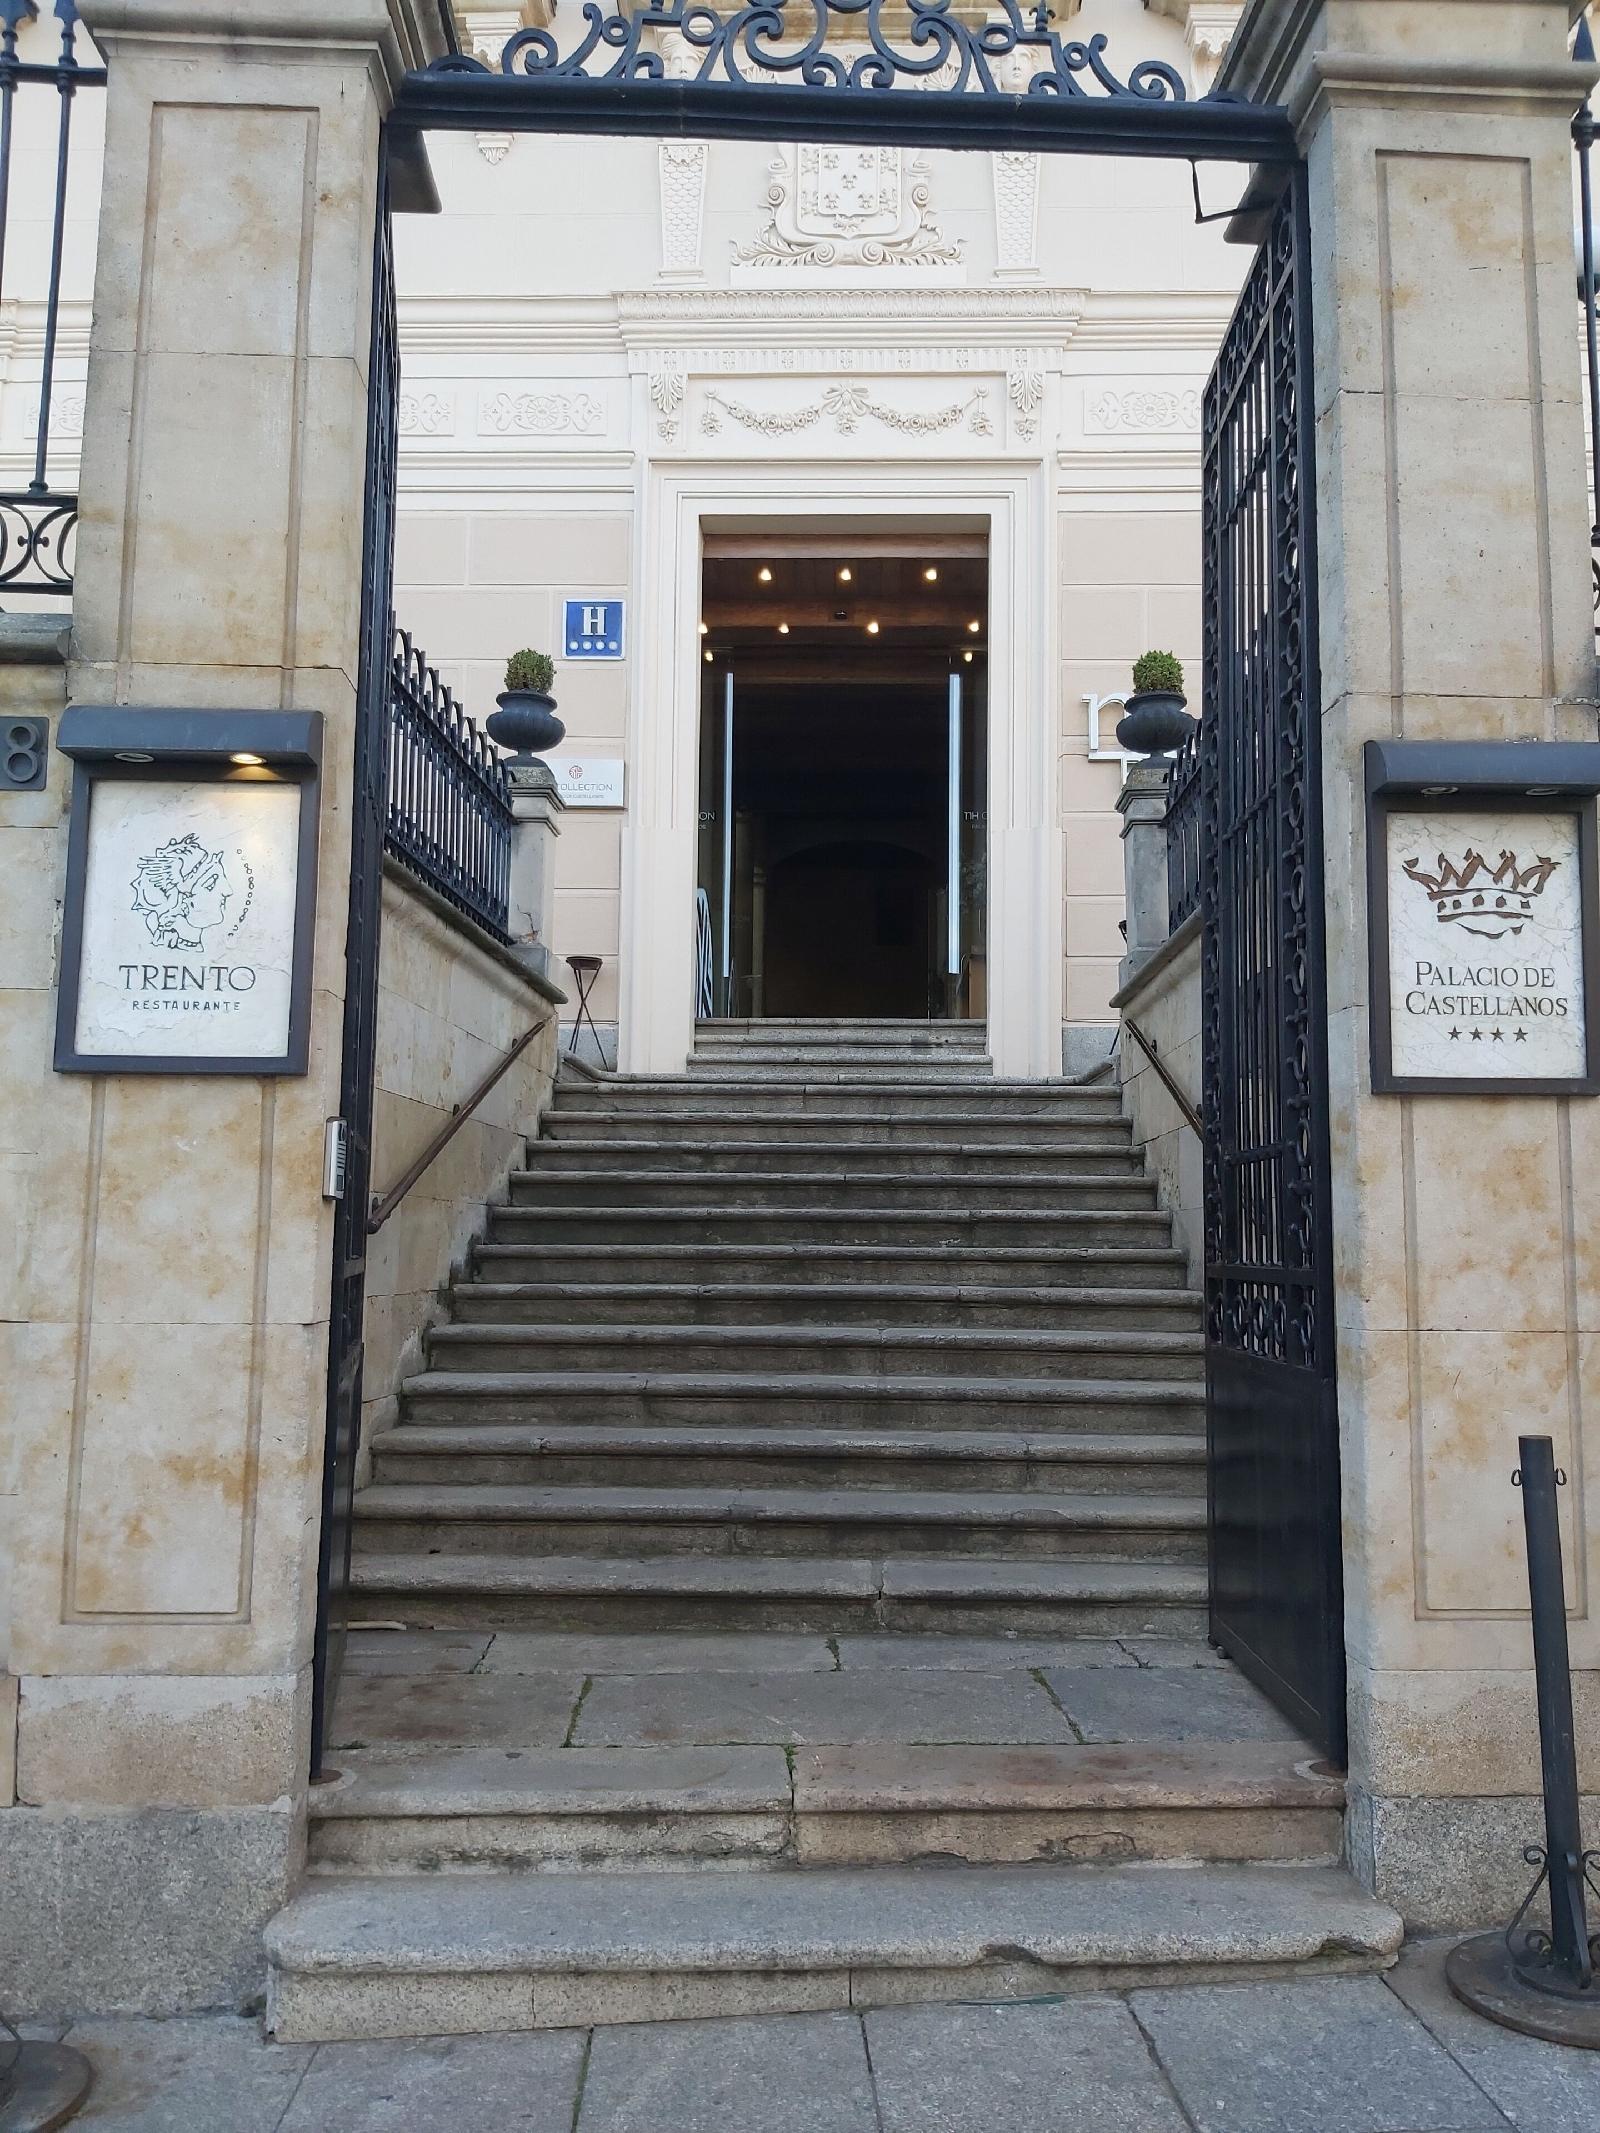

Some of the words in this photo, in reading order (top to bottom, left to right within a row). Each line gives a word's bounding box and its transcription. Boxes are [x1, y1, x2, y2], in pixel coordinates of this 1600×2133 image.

[580, 606, 608, 636] H
[2, 722, 39, 783] 8
[118, 964, 256, 991] TRENTO
[1415, 961, 1519, 987] PALACIO
[1523, 967, 1556, 988] DE
[132, 1000, 241, 1011] RESTAURANTE
[1405, 990, 1568, 1017] CASTELLANOS
